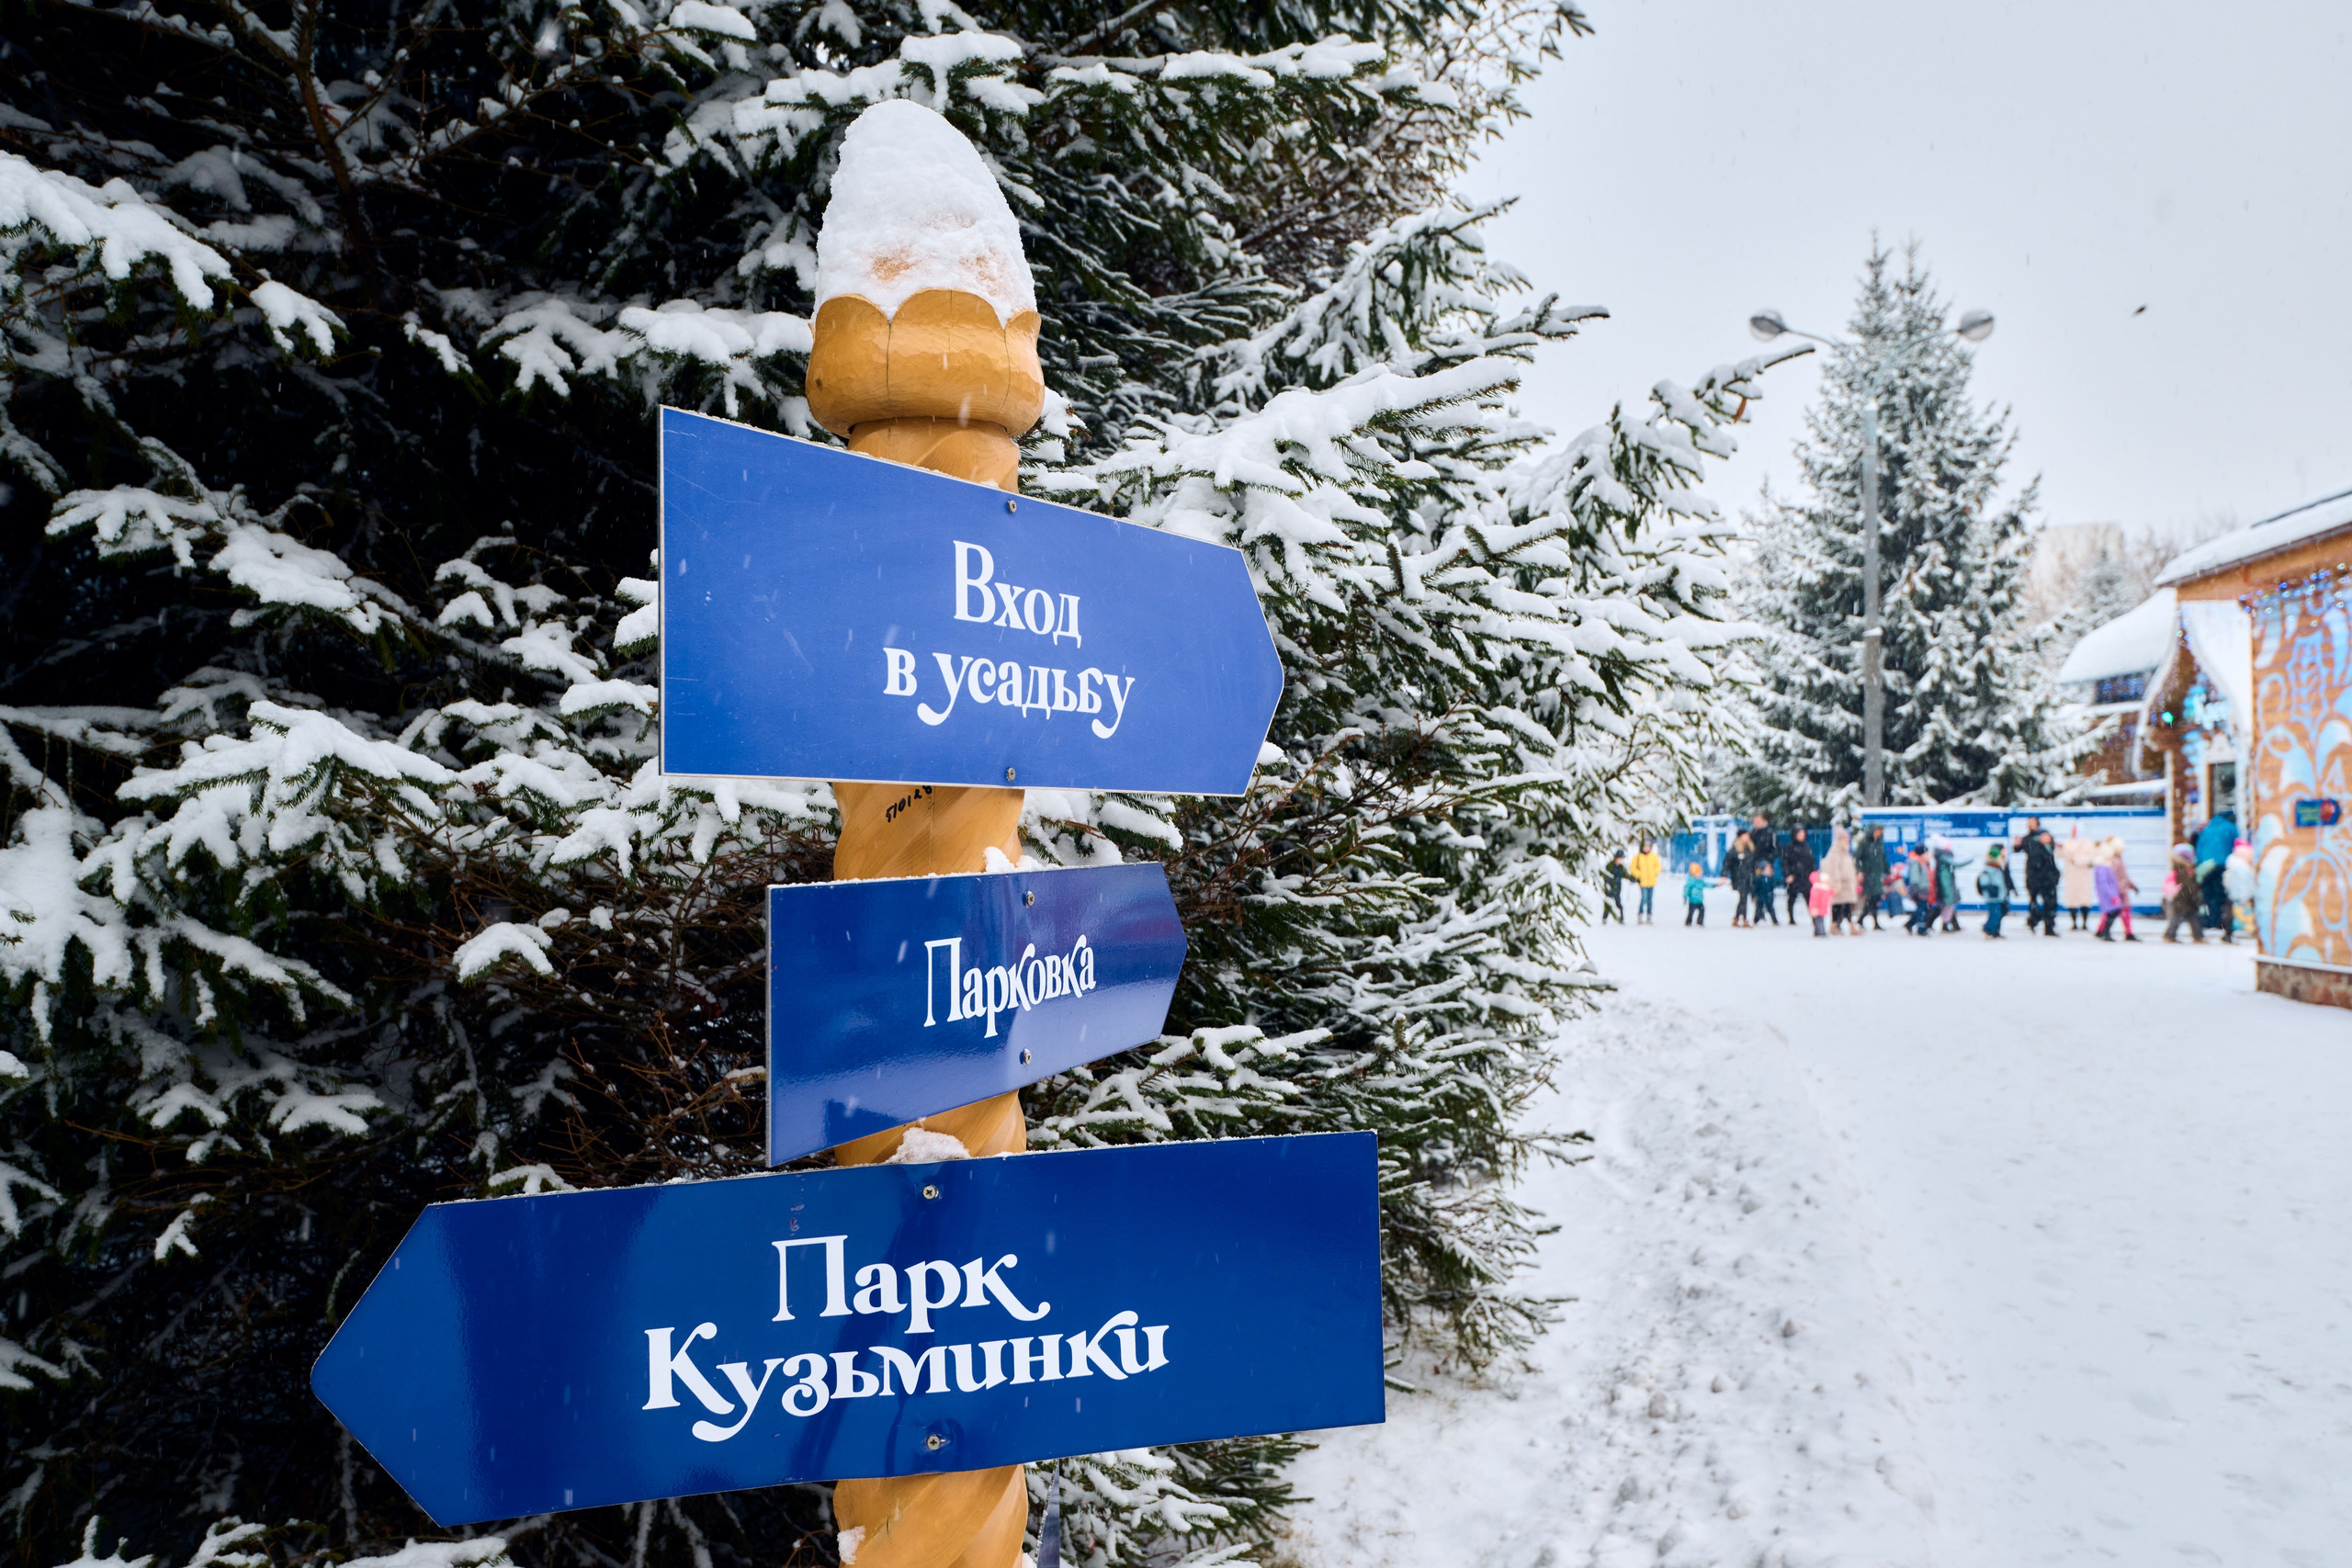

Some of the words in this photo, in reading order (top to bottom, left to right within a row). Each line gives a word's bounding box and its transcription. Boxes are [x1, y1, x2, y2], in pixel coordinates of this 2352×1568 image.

[953, 540, 1082, 649] Вход
[883, 647, 918, 697] в
[917, 651, 1136, 739] усадьбу
[923, 934, 1097, 1039] Парковка
[772, 1235, 1051, 1334] Парк
[642, 1310, 1170, 1442] Кузьминки
